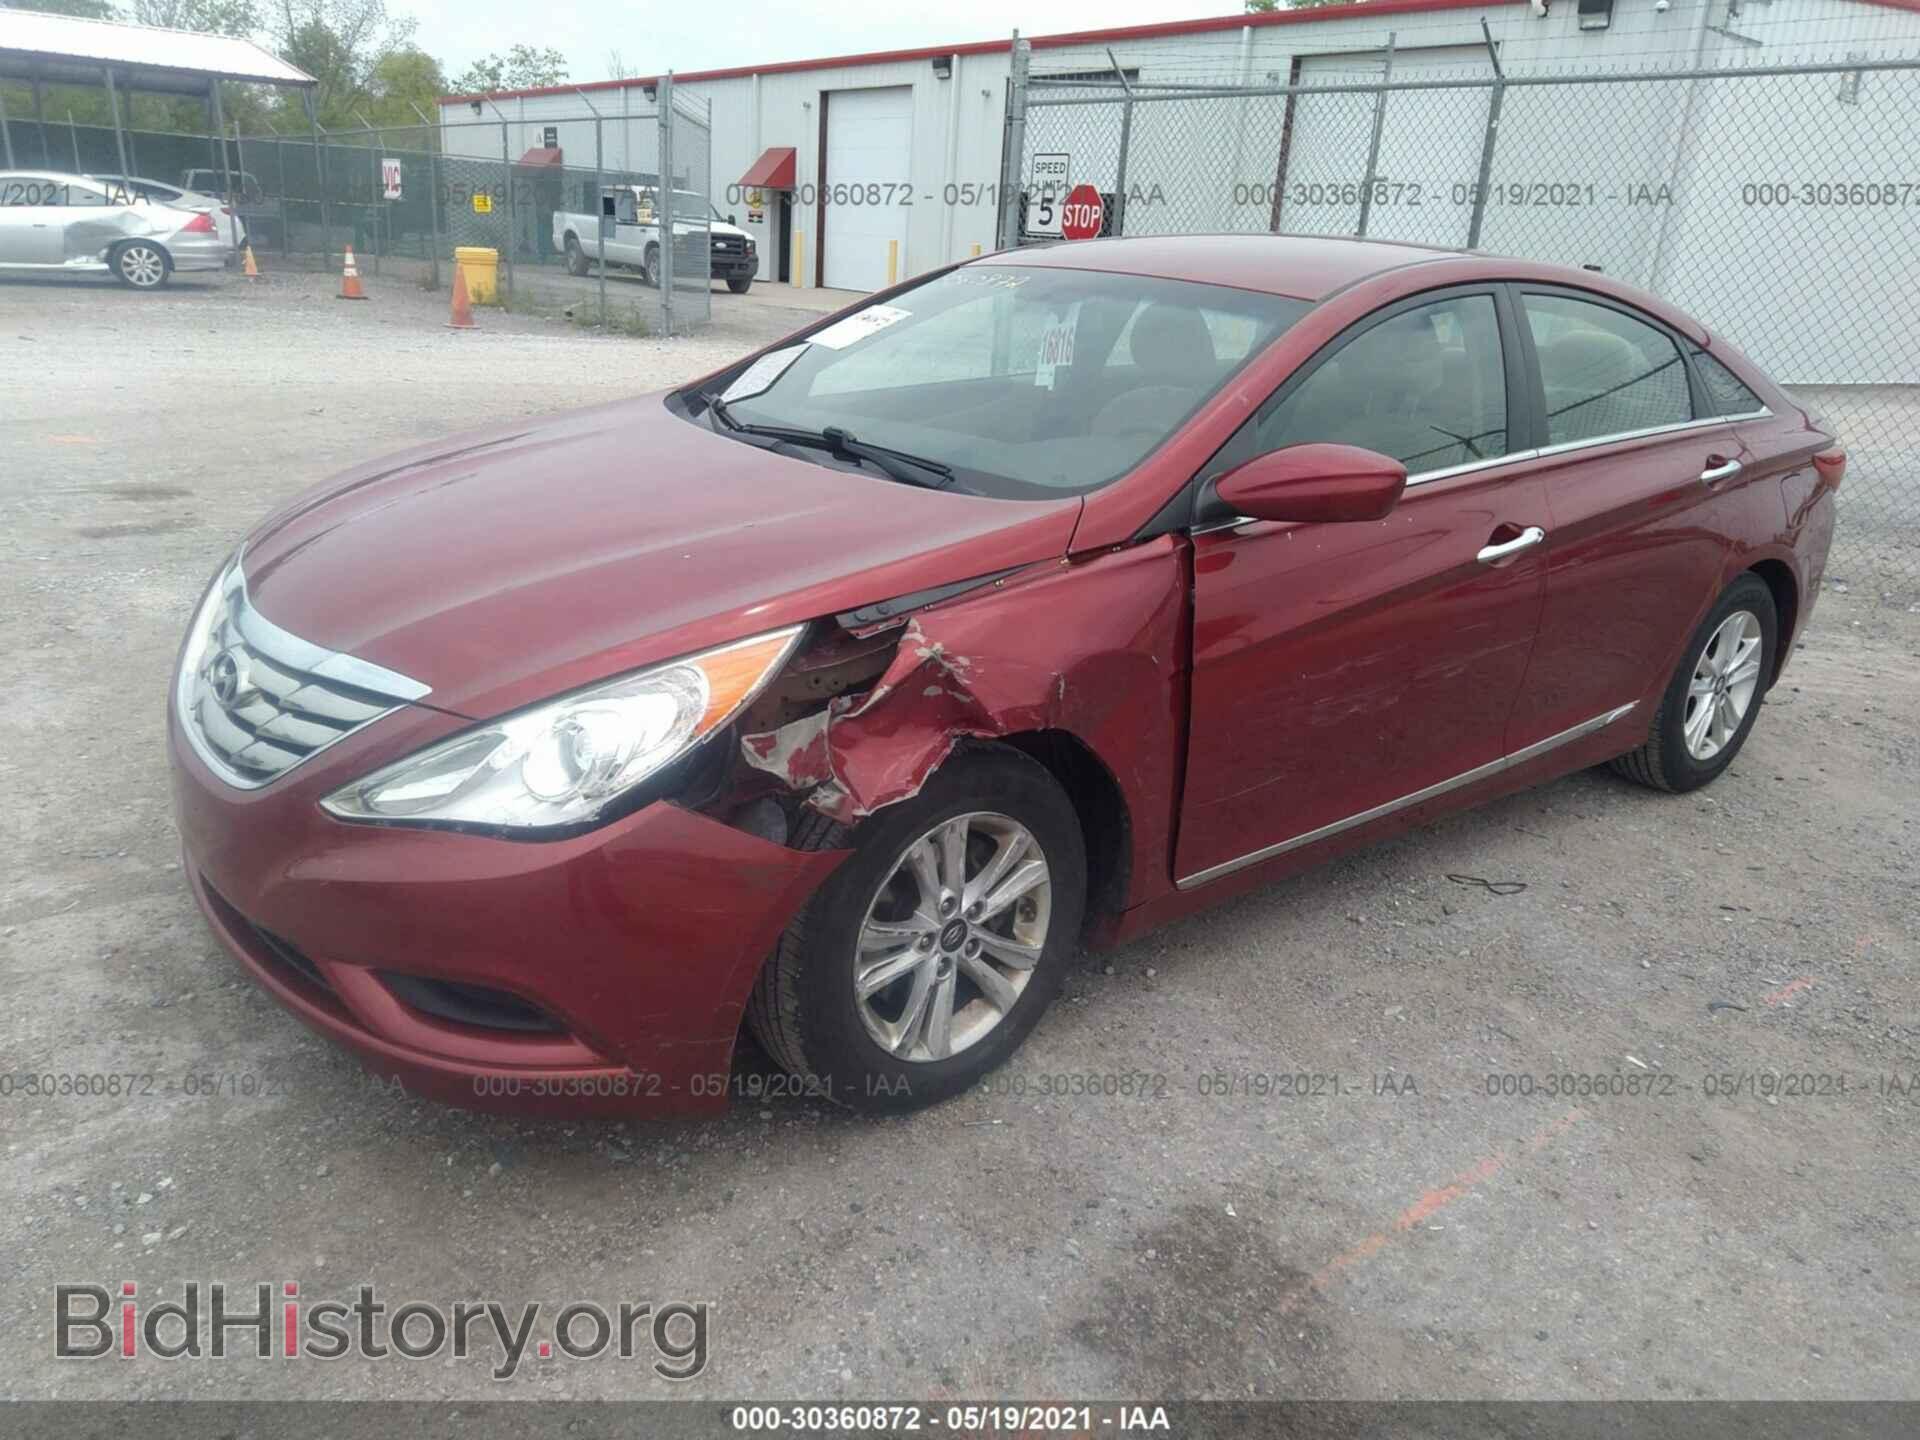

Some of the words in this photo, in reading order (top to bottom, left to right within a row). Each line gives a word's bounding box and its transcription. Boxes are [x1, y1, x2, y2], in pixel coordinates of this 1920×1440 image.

[1035, 162, 1066, 174] SPEED
[1038, 197, 1053, 226] 5
[1063, 204, 1100, 228] STOP
